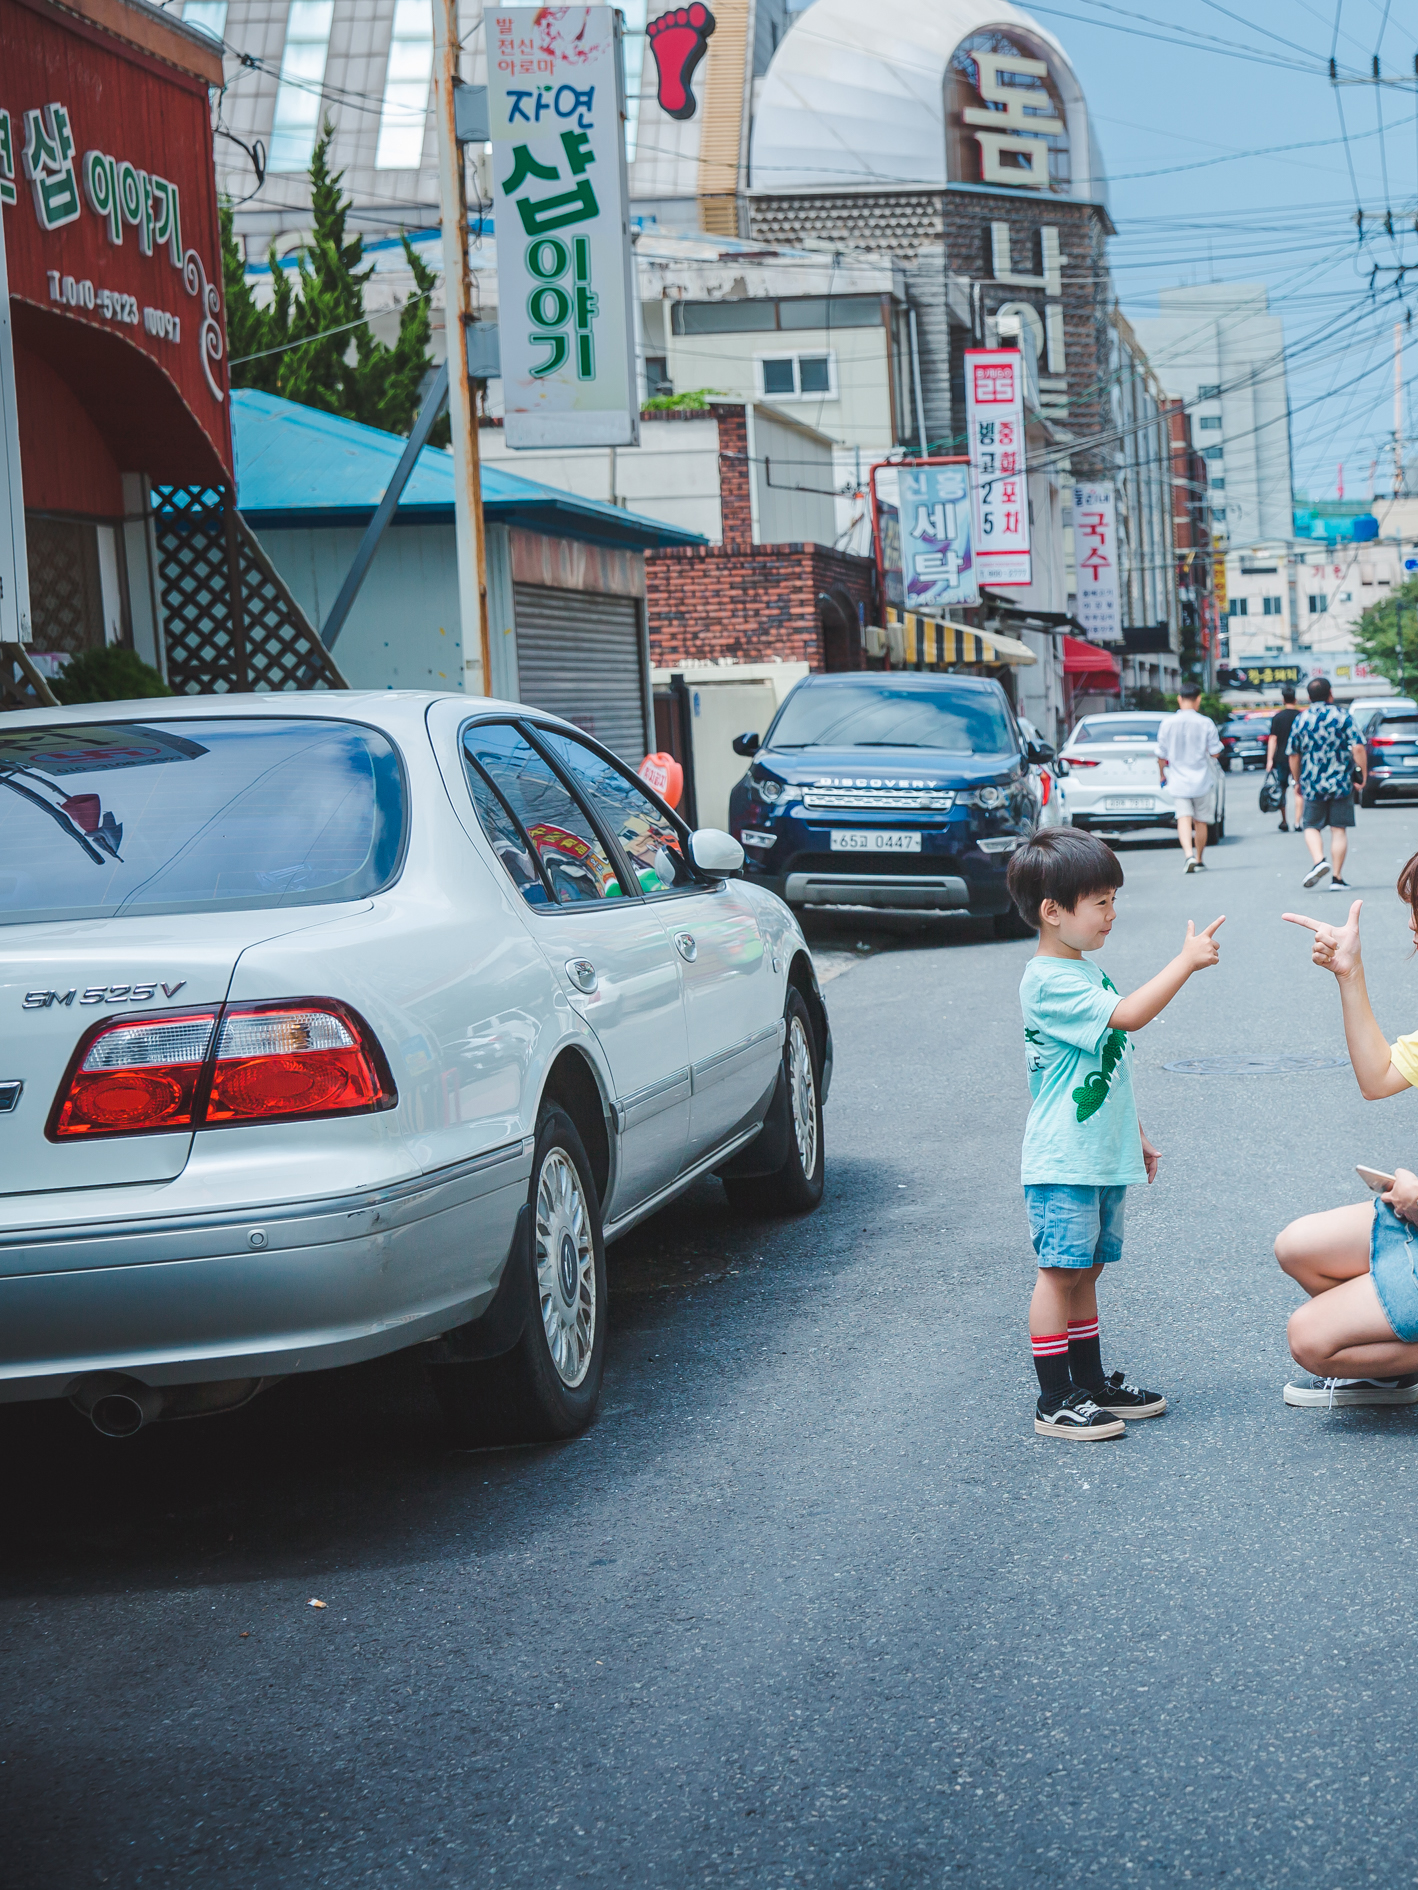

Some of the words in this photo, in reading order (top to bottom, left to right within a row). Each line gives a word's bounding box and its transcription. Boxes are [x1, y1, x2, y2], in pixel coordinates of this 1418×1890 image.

[496, 17, 514, 36] 발
[498, 59, 555, 77] 아로마
[506, 84, 595, 130] 자연
[962, 51, 1064, 189] 돔
[22, 102, 81, 230] 샵
[83, 150, 183, 269] 이야기
[502, 130, 600, 236] 샵
[524, 234, 599, 381] 이야기
[976, 379, 1013, 401] 25
[902, 471, 965, 499] 신흥
[999, 422, 1020, 534] 중화포차
[910, 502, 964, 588] 세탁
[1078, 511, 1112, 582] 국수
[820, 777, 938, 788] DISCOVERY
[875, 835, 913, 849] 0447
